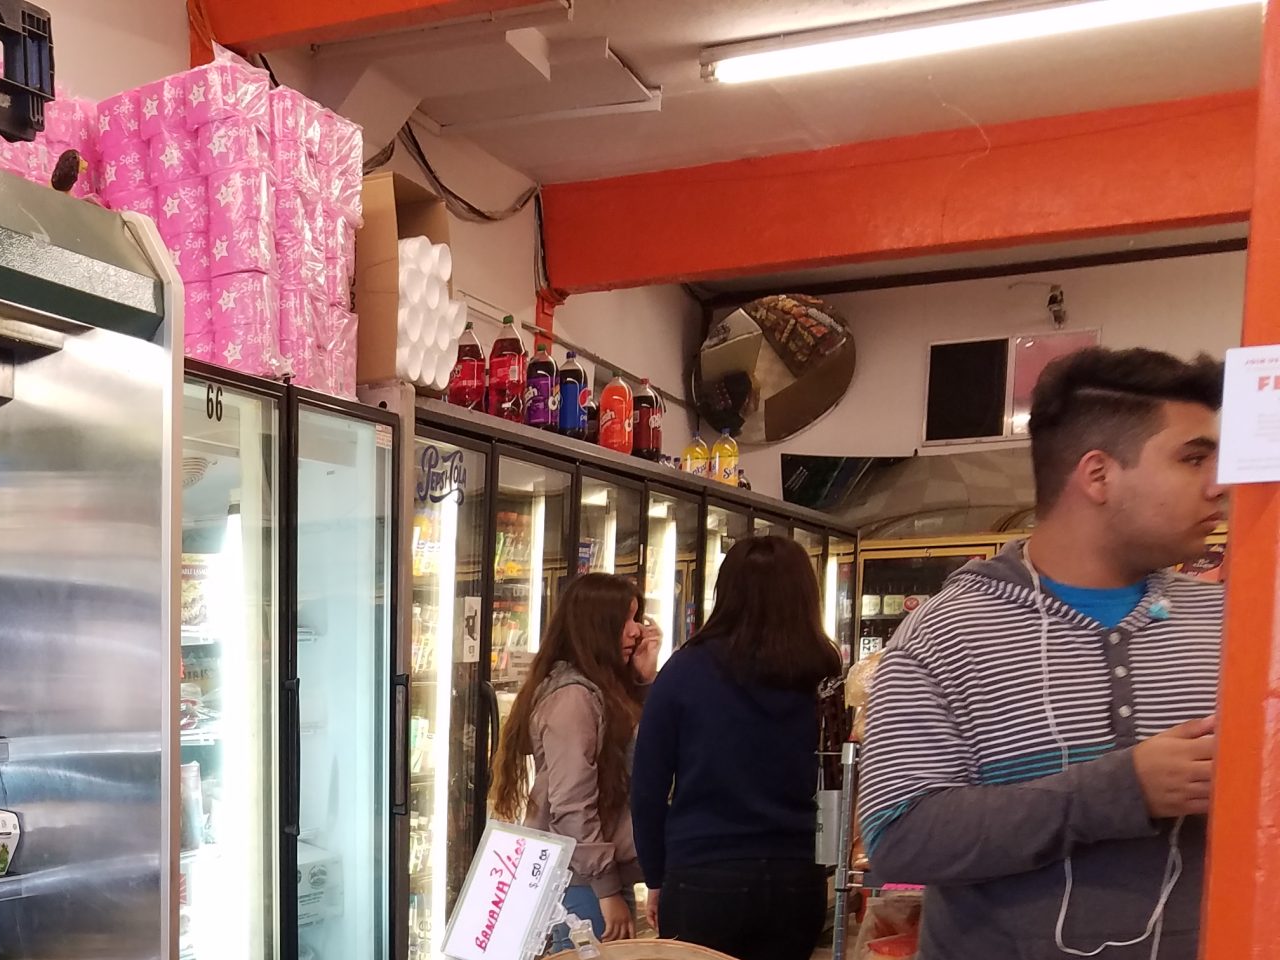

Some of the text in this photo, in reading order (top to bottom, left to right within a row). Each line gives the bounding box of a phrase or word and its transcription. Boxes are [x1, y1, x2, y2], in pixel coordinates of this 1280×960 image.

[113, 102, 134, 115] Soft
[119, 153, 141, 165] Soft
[184, 186, 206, 198] Soft
[133, 199, 154, 210] Soft
[185, 238, 207, 251] Soft
[241, 279, 262, 293] Soft
[206, 383, 223, 421] 66
[475, 880, 511, 953] BANANA
